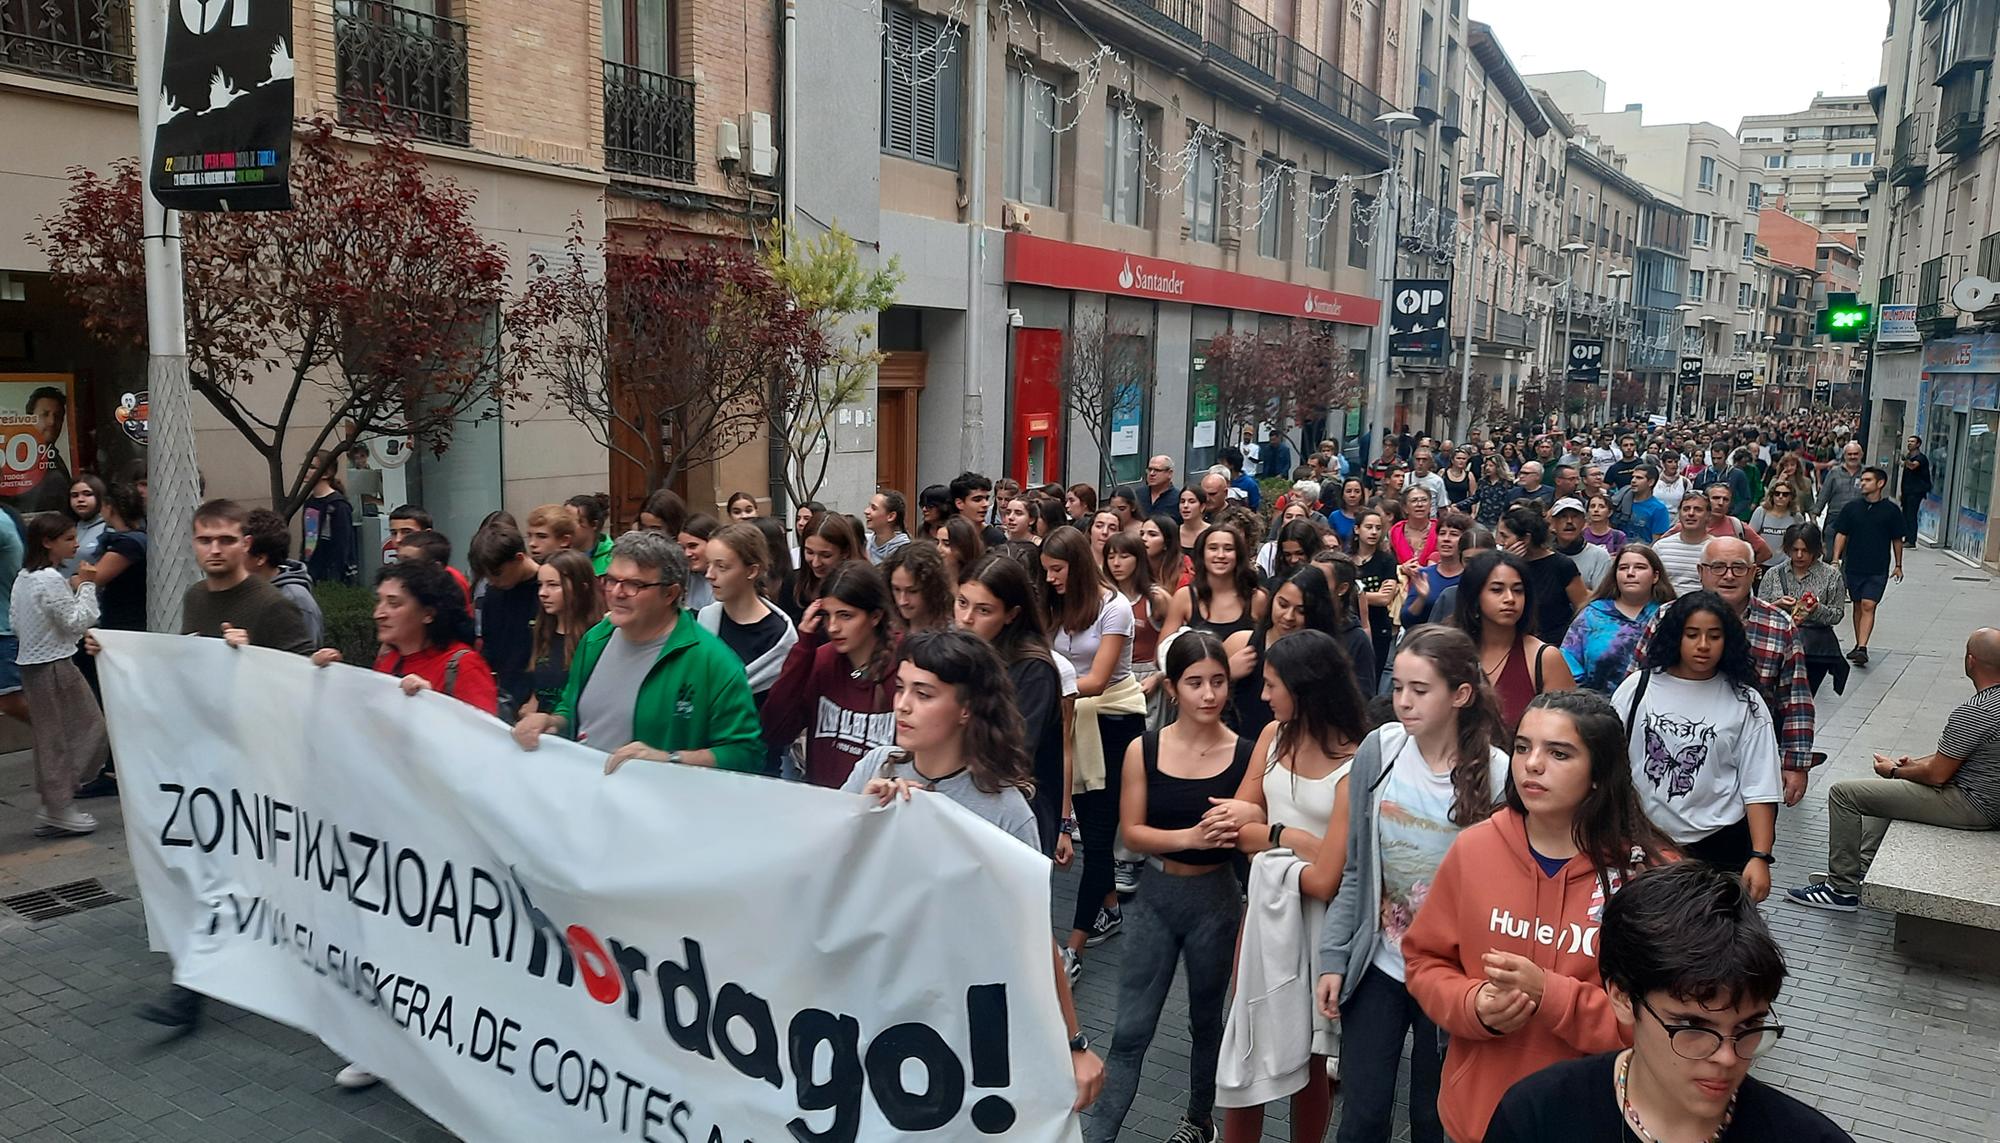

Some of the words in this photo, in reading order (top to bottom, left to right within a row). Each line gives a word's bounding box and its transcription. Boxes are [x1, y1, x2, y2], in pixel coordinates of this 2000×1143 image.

[1135, 264, 1185, 295] Santander
[1313, 295, 1342, 316] Santander
[1396, 289, 1444, 314] OP
[1572, 344, 1600, 360] OP
[1682, 361, 1701, 371] OP
[1739, 372, 1753, 380] OP
[529, 1036, 695, 1143] CORTES
